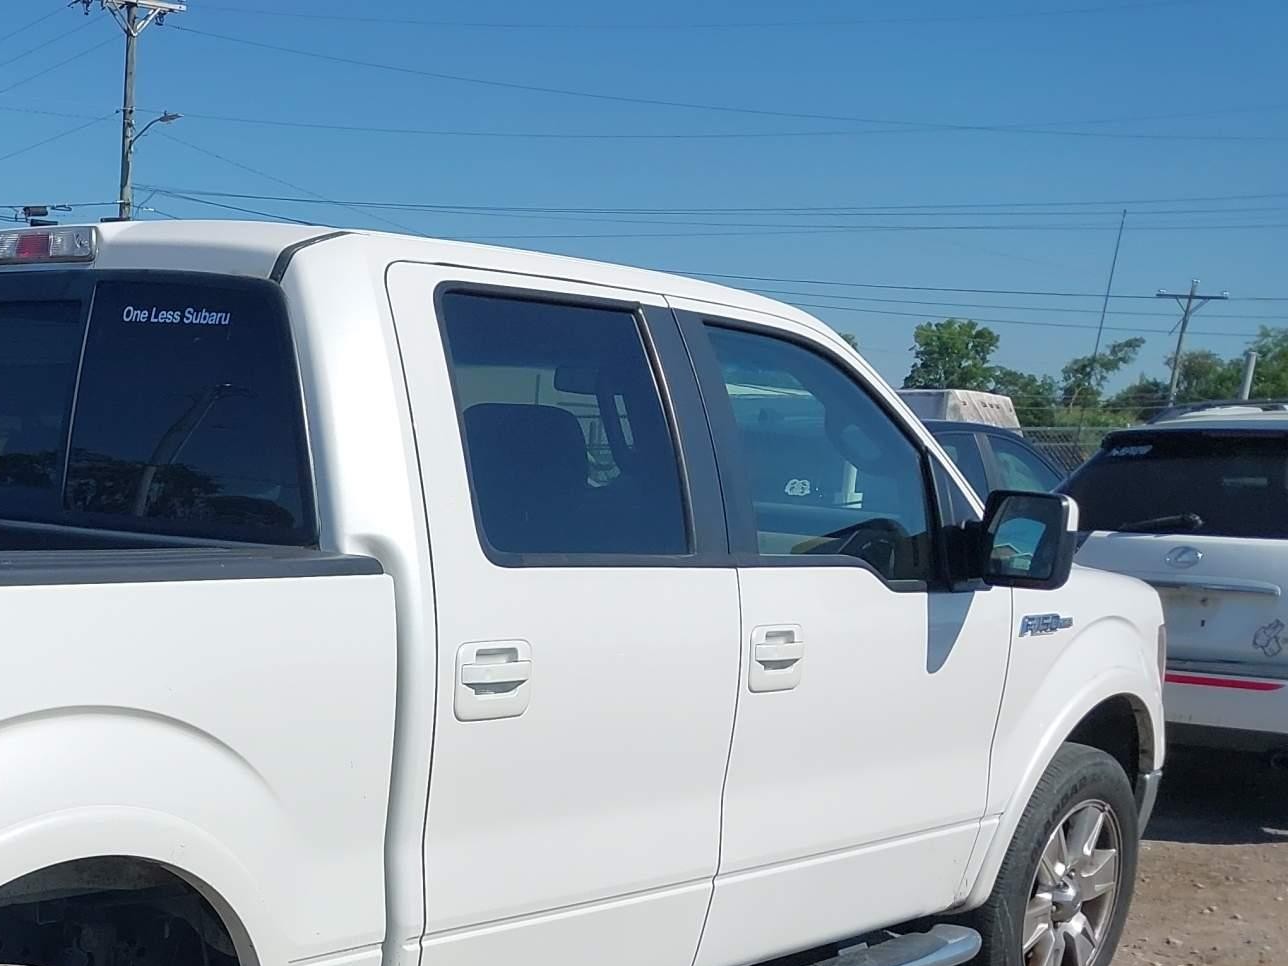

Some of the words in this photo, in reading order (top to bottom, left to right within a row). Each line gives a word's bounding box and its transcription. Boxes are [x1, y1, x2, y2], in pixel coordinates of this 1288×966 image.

[123, 305, 148, 322] One
[150, 307, 180, 323] Less
[183, 308, 230, 324] Subaru
